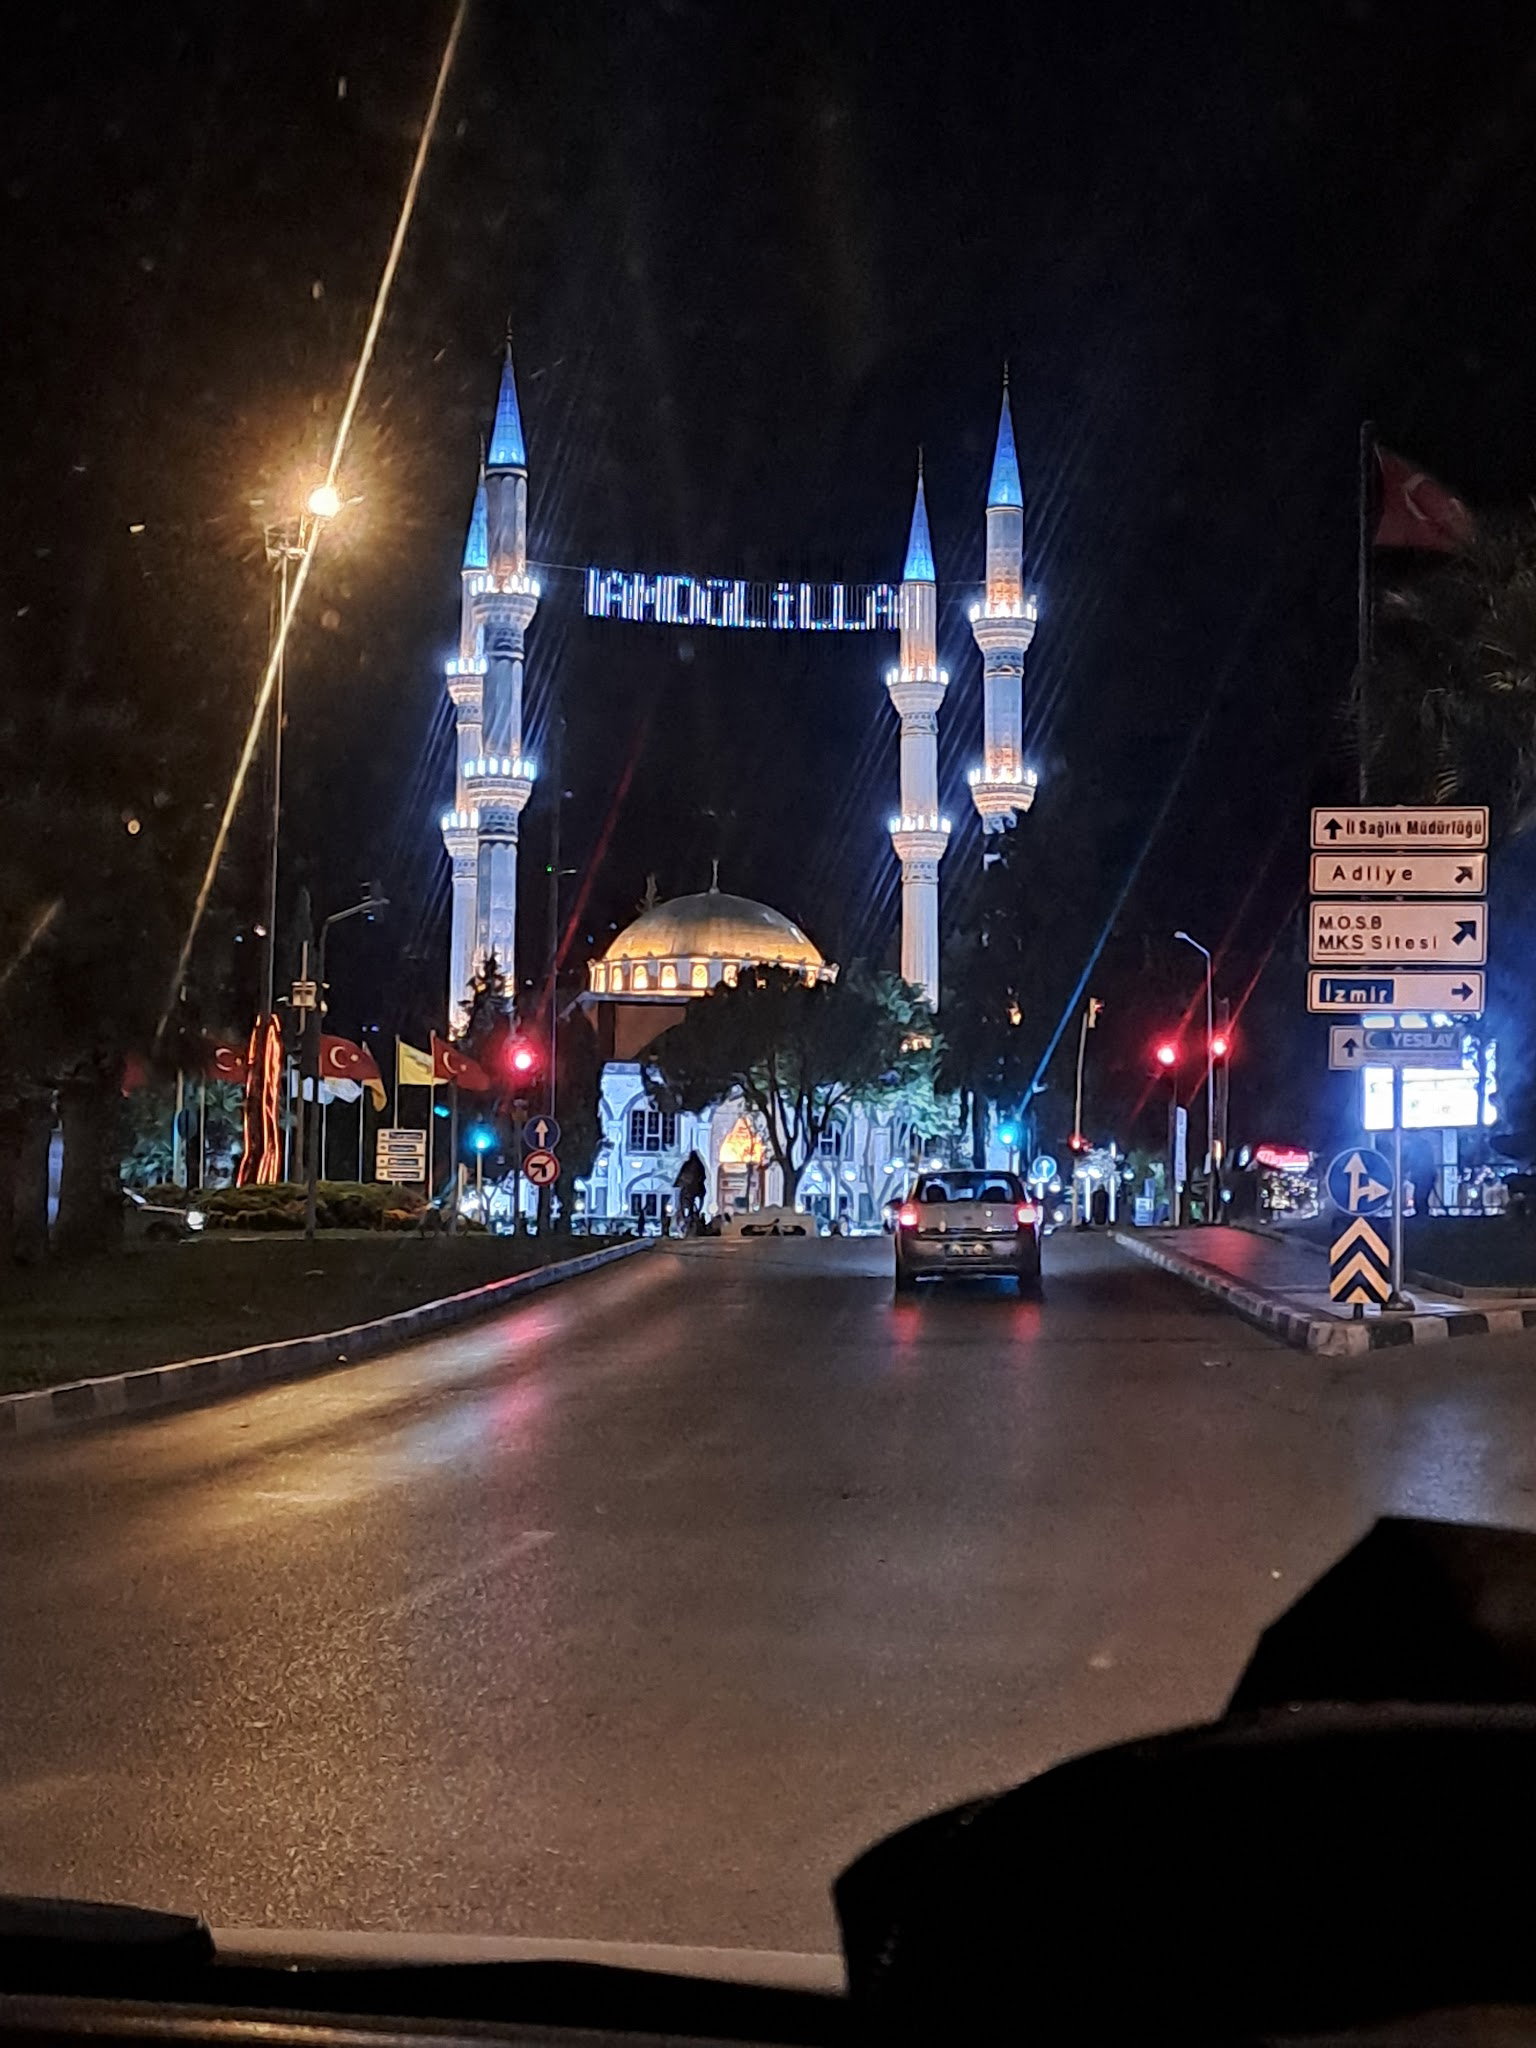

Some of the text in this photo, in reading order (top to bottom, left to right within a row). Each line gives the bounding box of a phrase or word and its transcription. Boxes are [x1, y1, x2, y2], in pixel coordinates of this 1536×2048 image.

[1359, 820, 1401, 838] Sağlık
[1406, 820, 1482, 839] Müdürlüğü
[1332, 865, 1413, 885] Adliye
[1371, 935, 1437, 950] Sitesi
